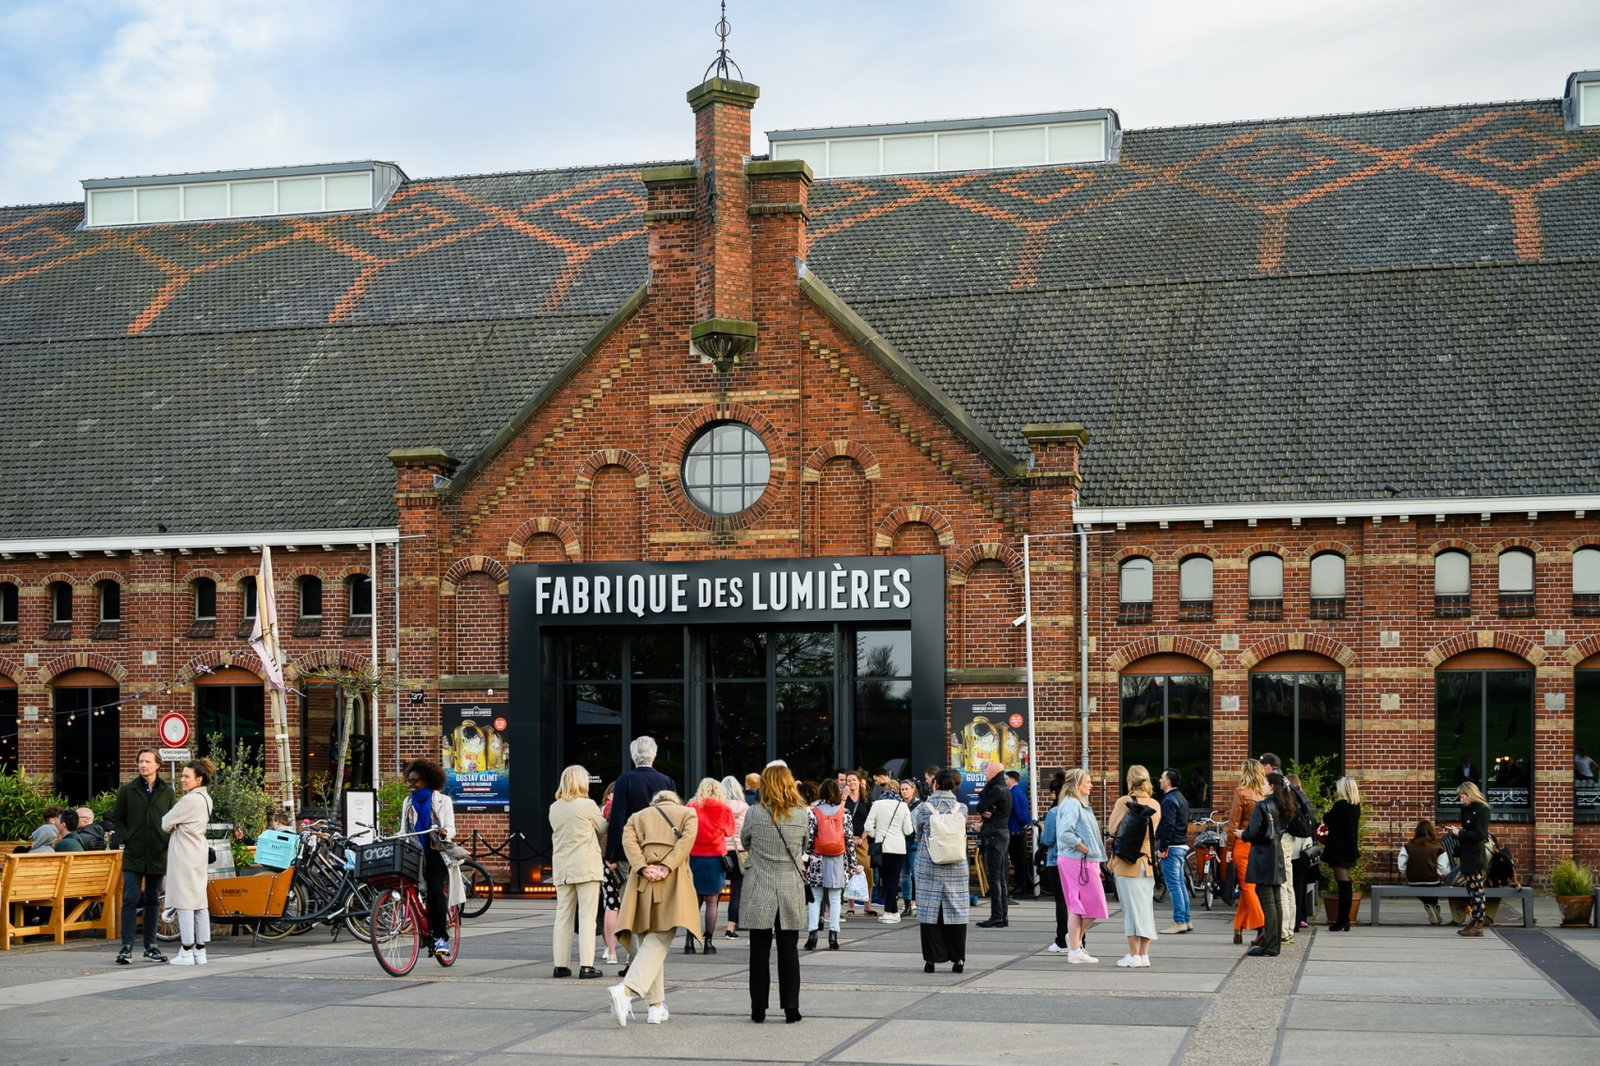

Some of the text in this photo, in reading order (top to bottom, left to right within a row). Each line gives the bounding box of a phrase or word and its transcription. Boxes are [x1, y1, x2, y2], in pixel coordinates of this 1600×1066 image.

[535, 562, 912, 618] FABRIQUE DES LUMIÈRES
[411, 692, 423, 700] 37
[456, 773, 498, 782] GUSTAV KLIMT
[966, 773, 986, 782] GUSTA
